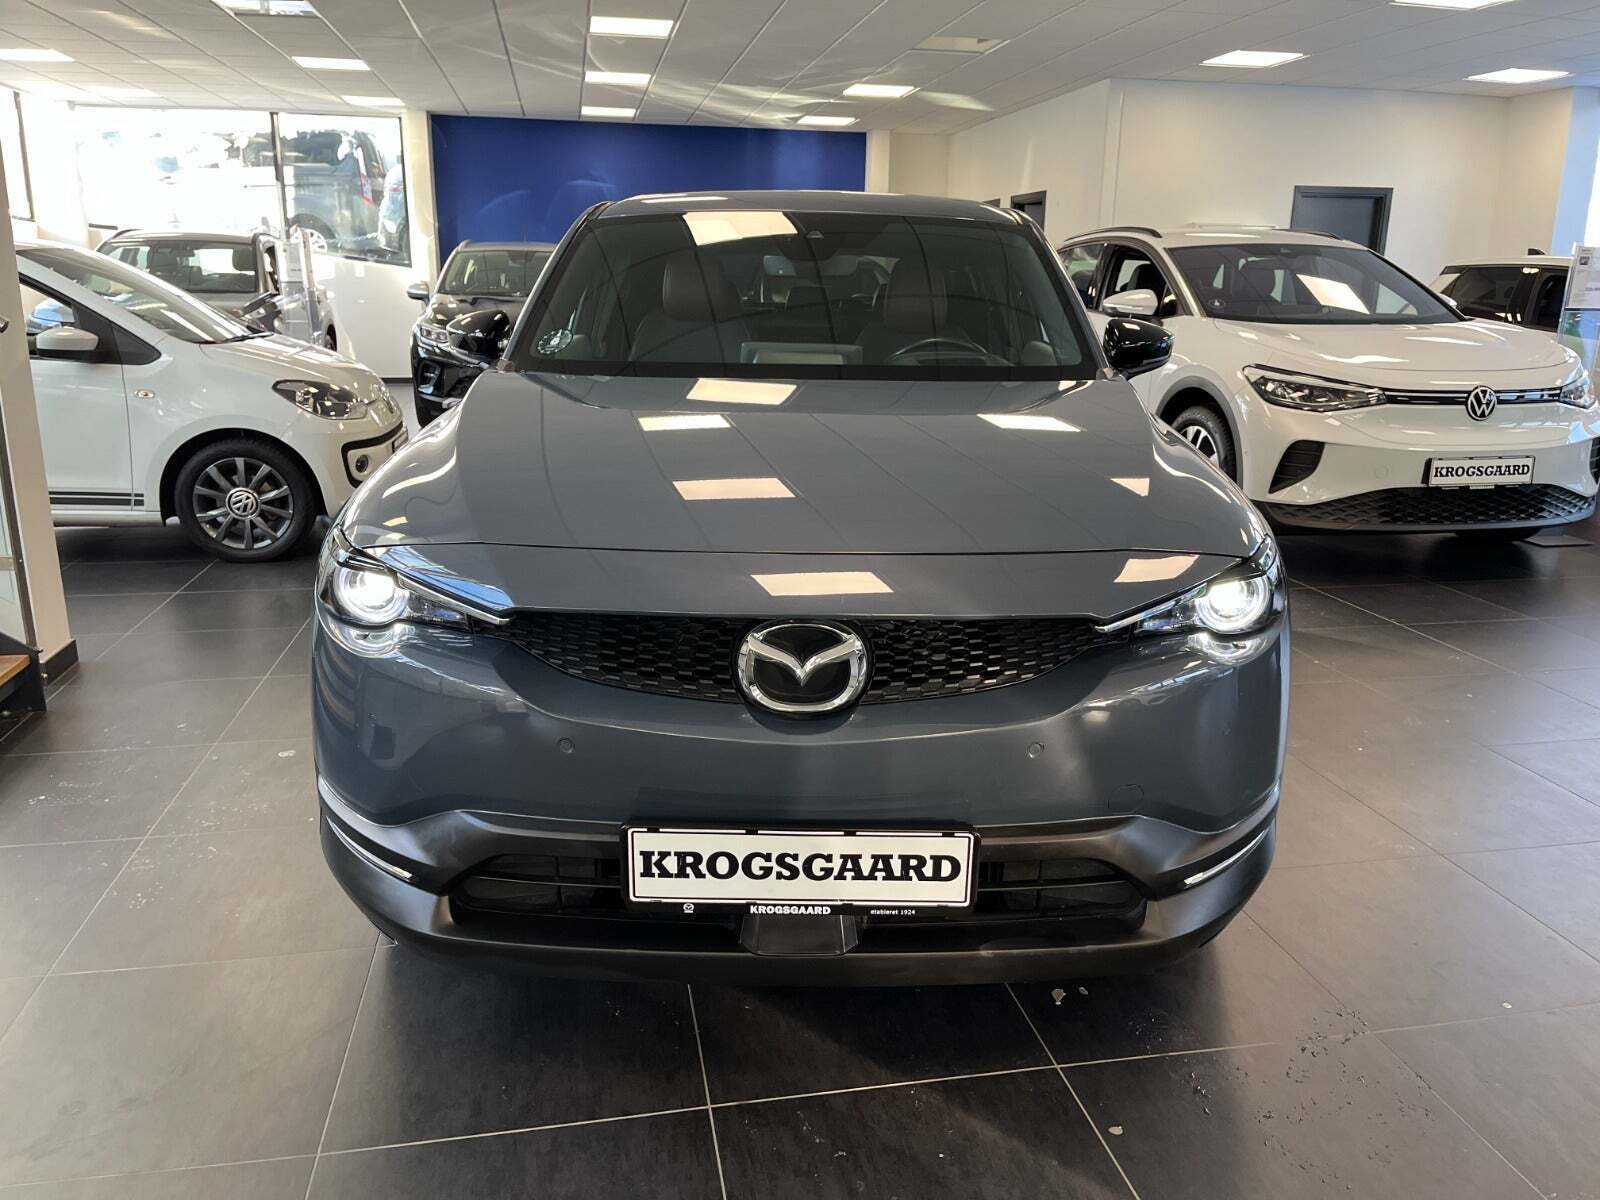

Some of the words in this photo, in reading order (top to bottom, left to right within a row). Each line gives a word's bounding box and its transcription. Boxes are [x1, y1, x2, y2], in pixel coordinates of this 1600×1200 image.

[1433, 464, 1530, 478] KROGSGAARD
[639, 850, 962, 883] KROGSGAARD
[750, 905, 832, 915] KROGSGAARD
